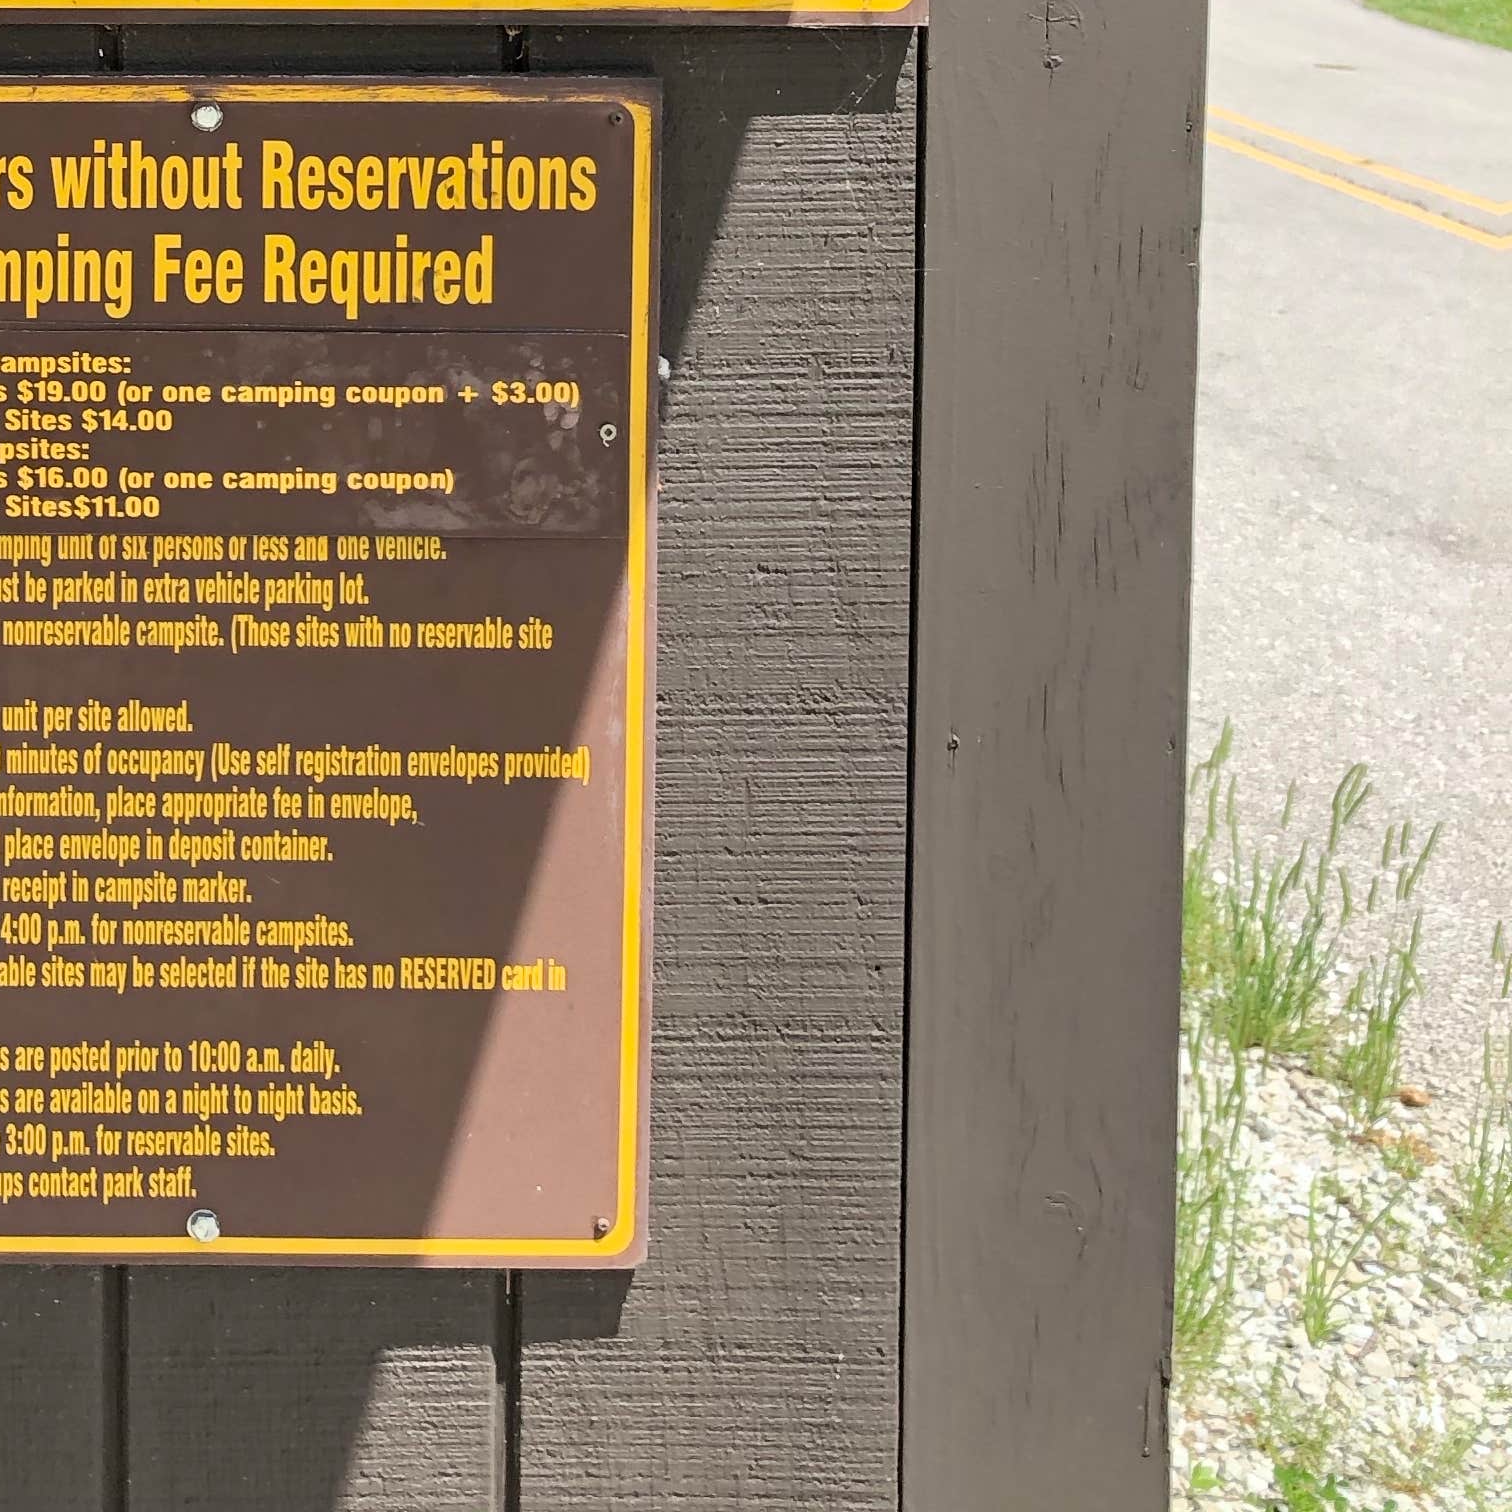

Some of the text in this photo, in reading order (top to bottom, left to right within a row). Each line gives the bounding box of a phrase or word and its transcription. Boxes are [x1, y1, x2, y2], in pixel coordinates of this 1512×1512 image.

[50, 139, 243, 210] without
[261, 140, 597, 212] Reservations
[153, 233, 244, 304] Fee
[263, 234, 494, 320] Required
[17, 379, 107, 403] $19.00
[118, 380, 152, 406] (or
[163, 385, 211, 402] one
[223, 385, 336, 406] camping
[347, 386, 446, 408] coupon
[458, 386, 478, 404] +
[493, 380, 580, 407] $3.00)
[6, 408, 73, 430] Sites
[83, 408, 173, 431] $14.00
[5, 744, 79, 774] minutes
[85, 745, 102, 774] of
[108, 749, 205, 781] occupancy
[214, 742, 251, 776] (Use
[257, 743, 291, 776] self
[295, 747, 402, 782] registration
[409, 748, 500, 782] envelopes
[504, 744, 593, 783] provided)
[30, 1168, 98, 1198] contact
[102, 1166, 143, 1200] park
[149, 1166, 197, 1197] staff.
